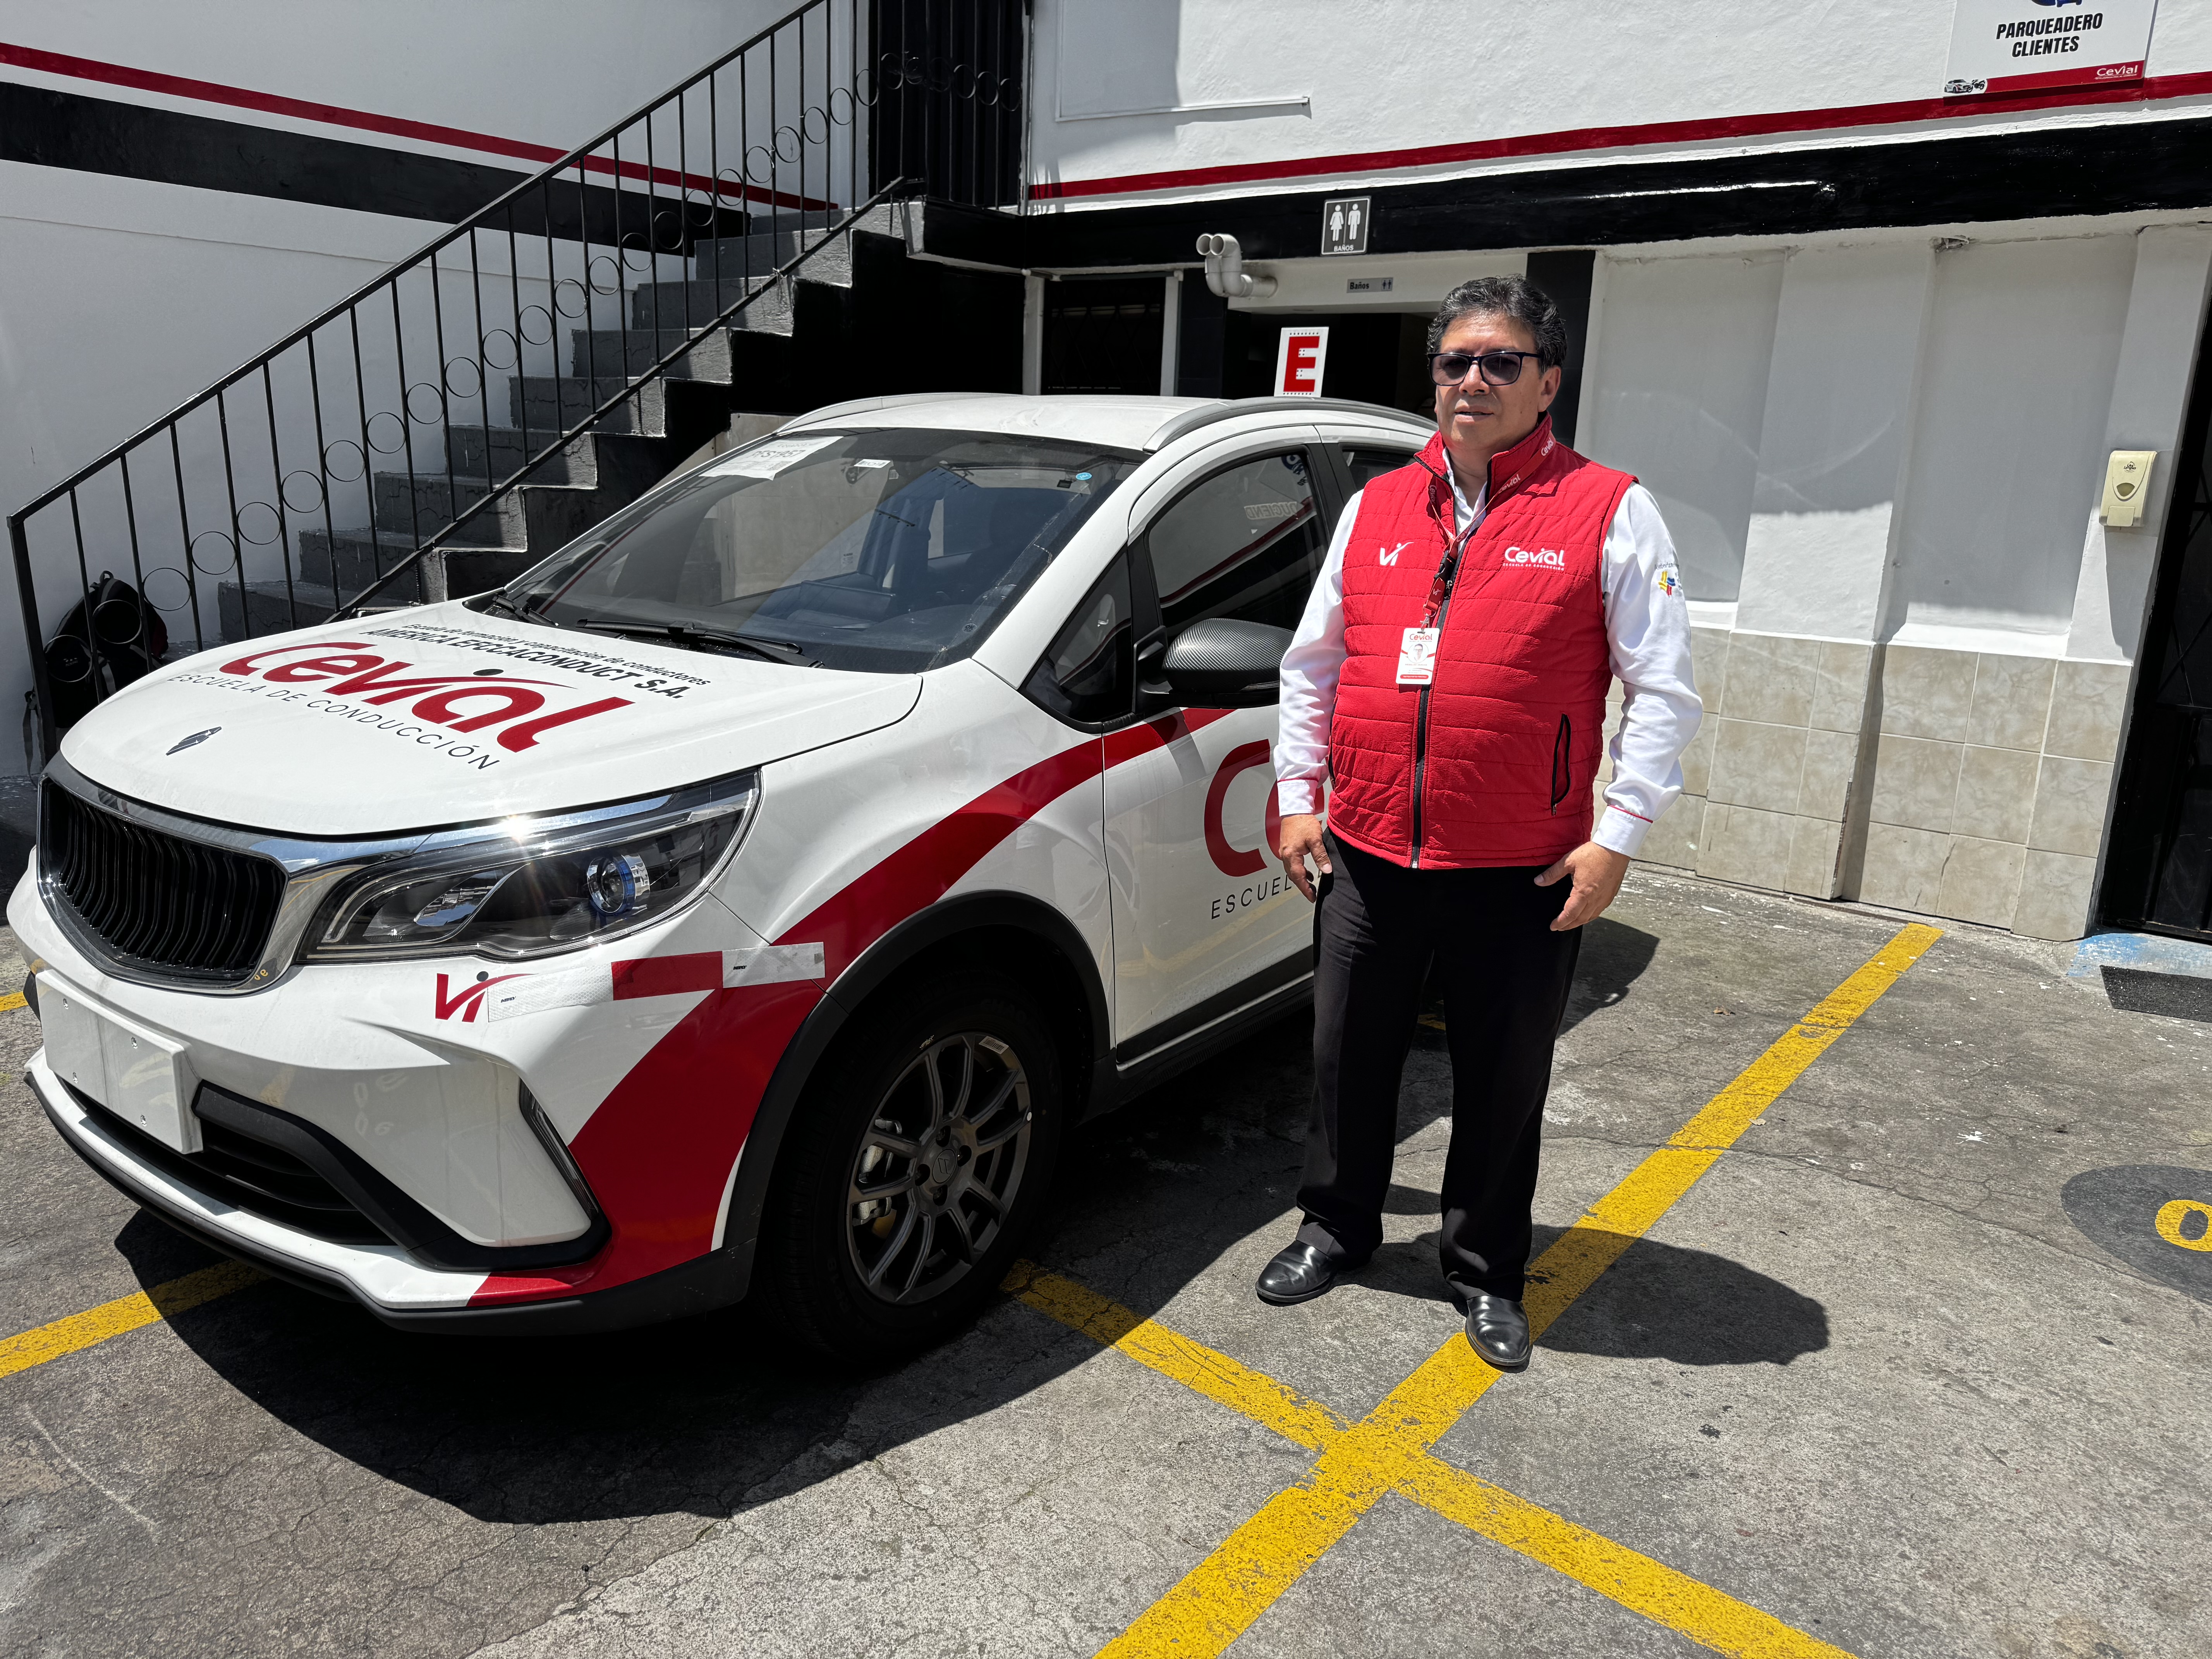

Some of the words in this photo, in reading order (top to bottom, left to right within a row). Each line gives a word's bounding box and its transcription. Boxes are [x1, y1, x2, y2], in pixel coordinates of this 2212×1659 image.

[1996, 13, 2103, 40] PARQUEADERO
[2012, 36, 2080, 57] CLIENTES
[2097, 65, 2138, 76] Cevial
[1283, 336, 1320, 392] E
[1505, 546, 1565, 566] Cevial
[359, 629, 460, 644] AMERICA
[447, 639, 644, 681] EFCCACONDUCT
[634, 679, 691, 699] S.A.
[622, 662, 711, 685] conductores
[219, 642, 636, 753] Cevial
[167, 675, 267, 693] ESCUELA
[265, 690, 308, 702] DE
[307, 700, 500, 770] CONDUCCIÓN
[1211, 874, 1292, 920] ESCUEL
